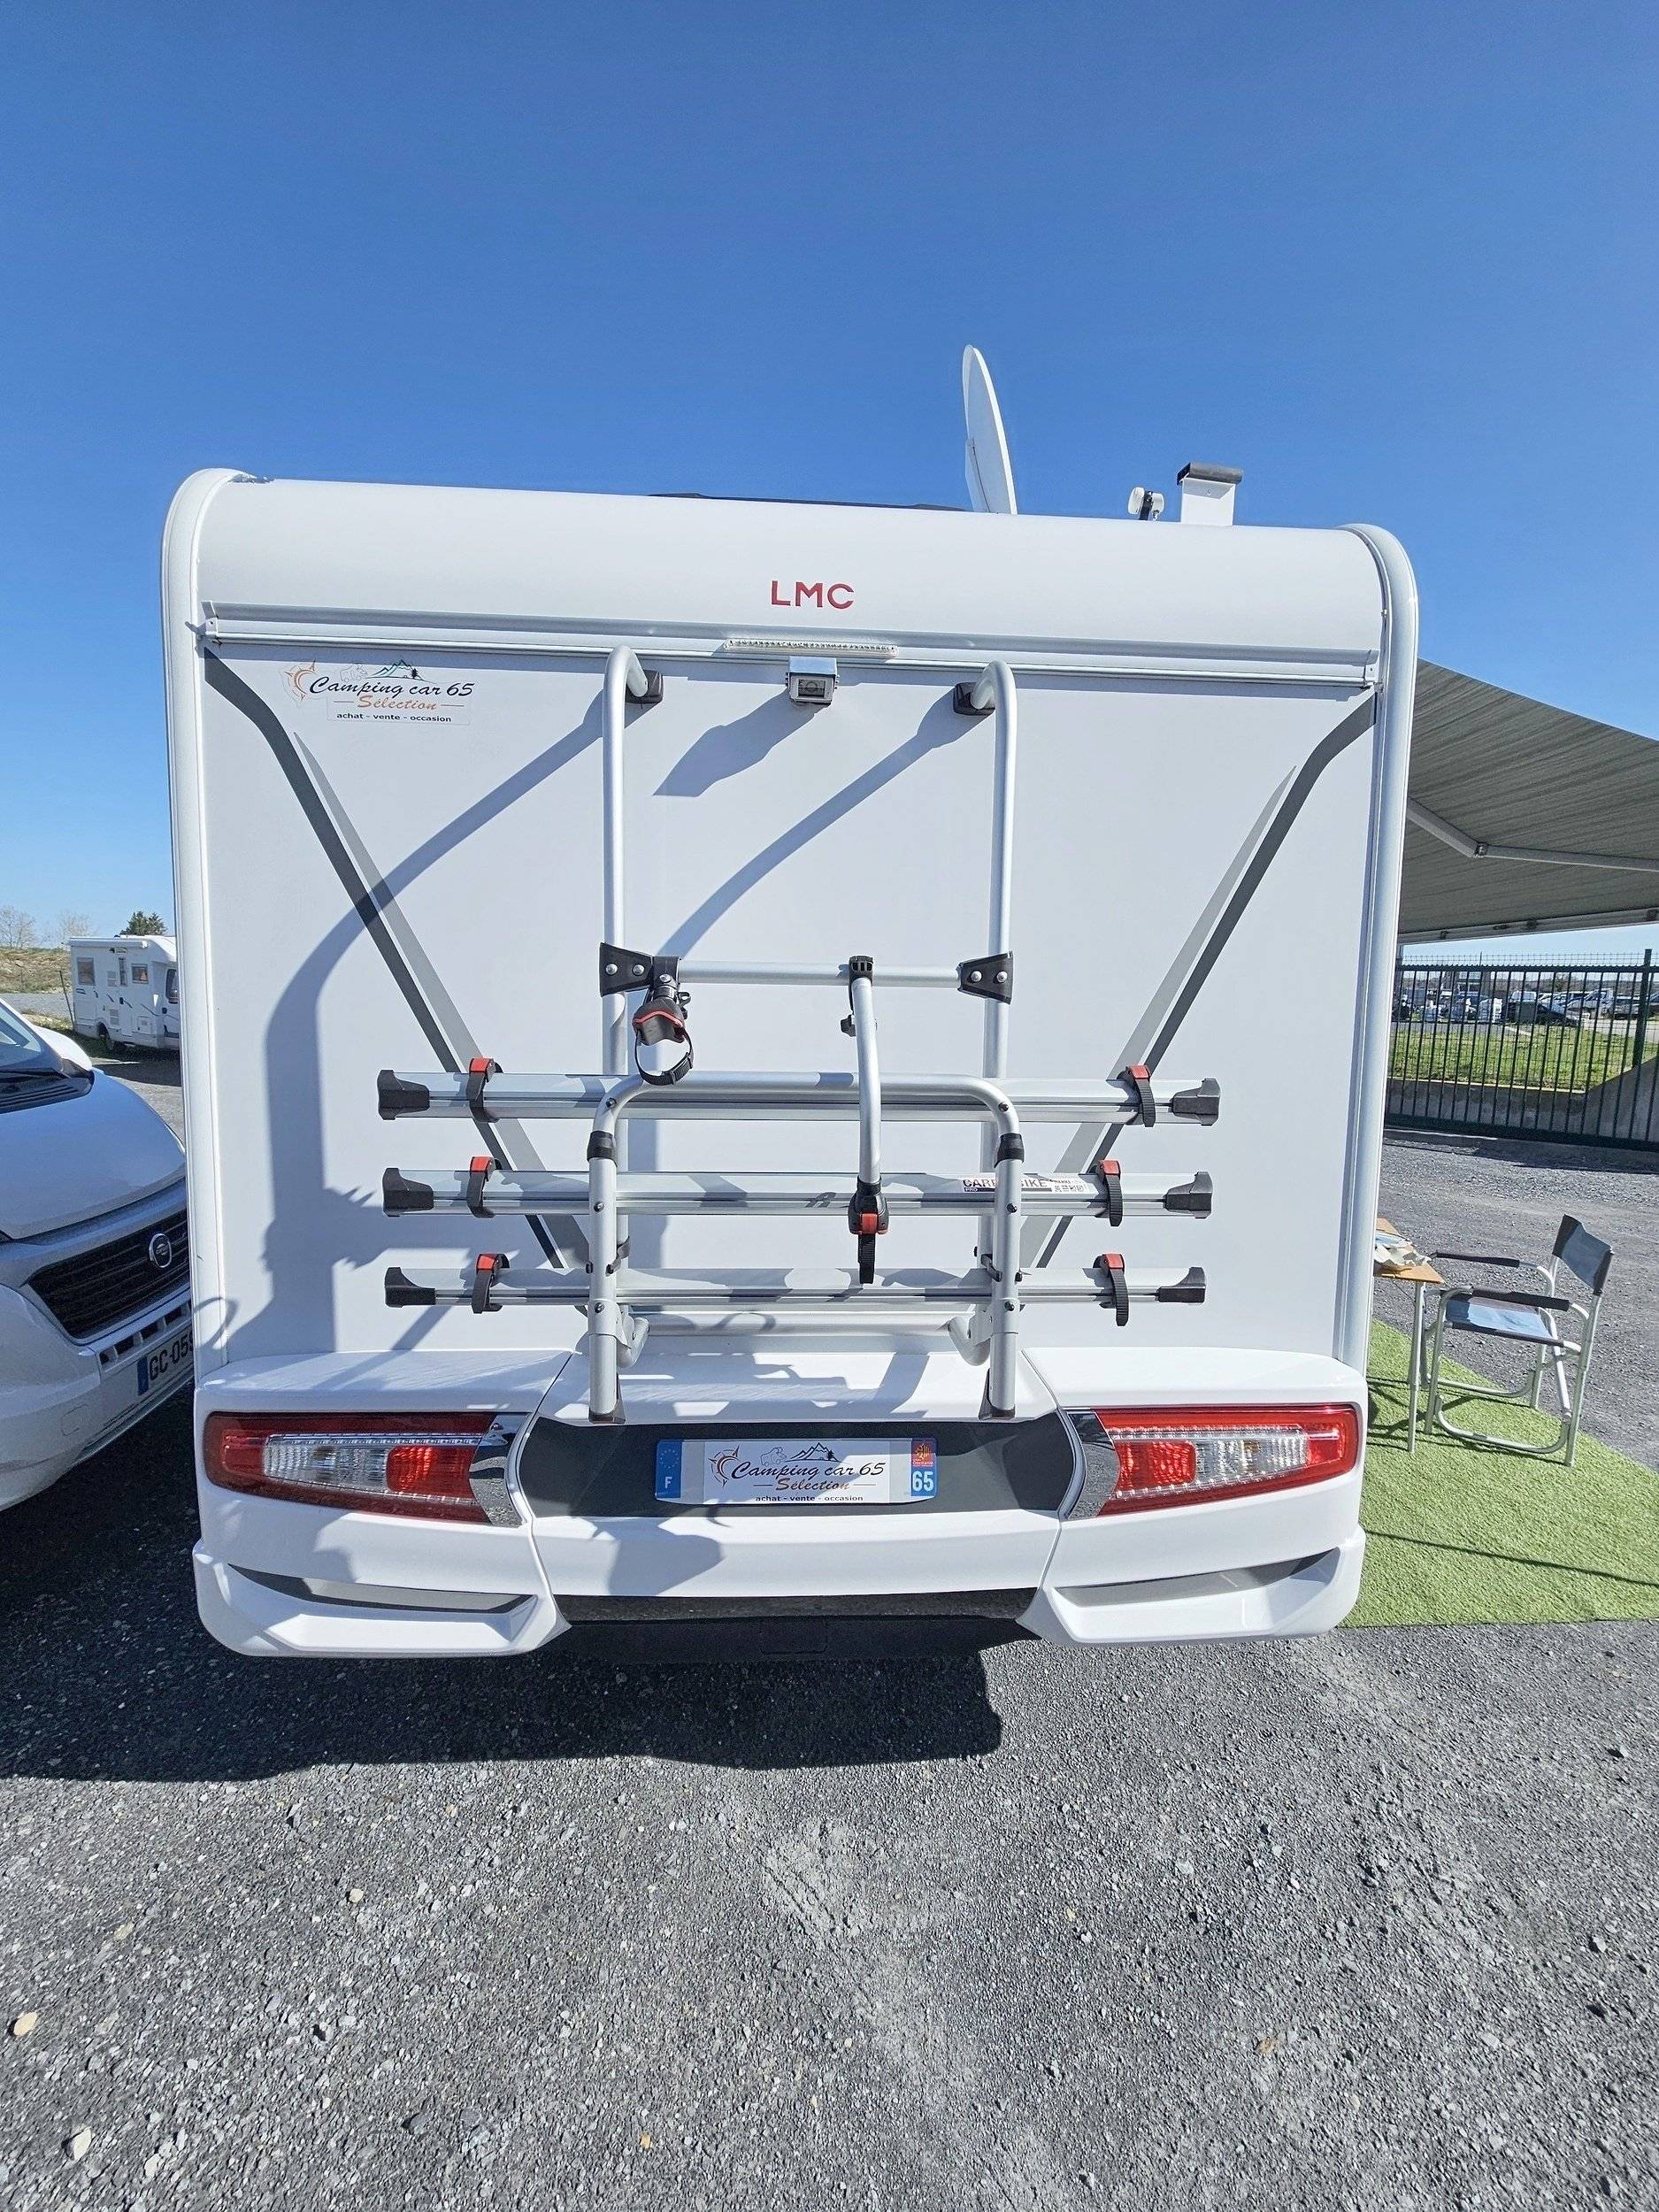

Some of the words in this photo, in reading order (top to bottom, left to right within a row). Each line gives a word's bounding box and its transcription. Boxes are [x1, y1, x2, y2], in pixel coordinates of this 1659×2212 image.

[771, 580, 855, 610] LMC
[309, 676, 404, 698] Camping
[409, 685, 442, 696] car
[446, 682, 476, 696] 65
[336, 711, 364, 720] achat
[731, 1461, 820, 1479] Camping
[824, 1466, 856, 1477] car
[858, 1463, 886, 1476] 65
[664, 1476, 672, 1489] F
[775, 1477, 849, 1491] Sélection
[912, 1471, 934, 1492] 65
